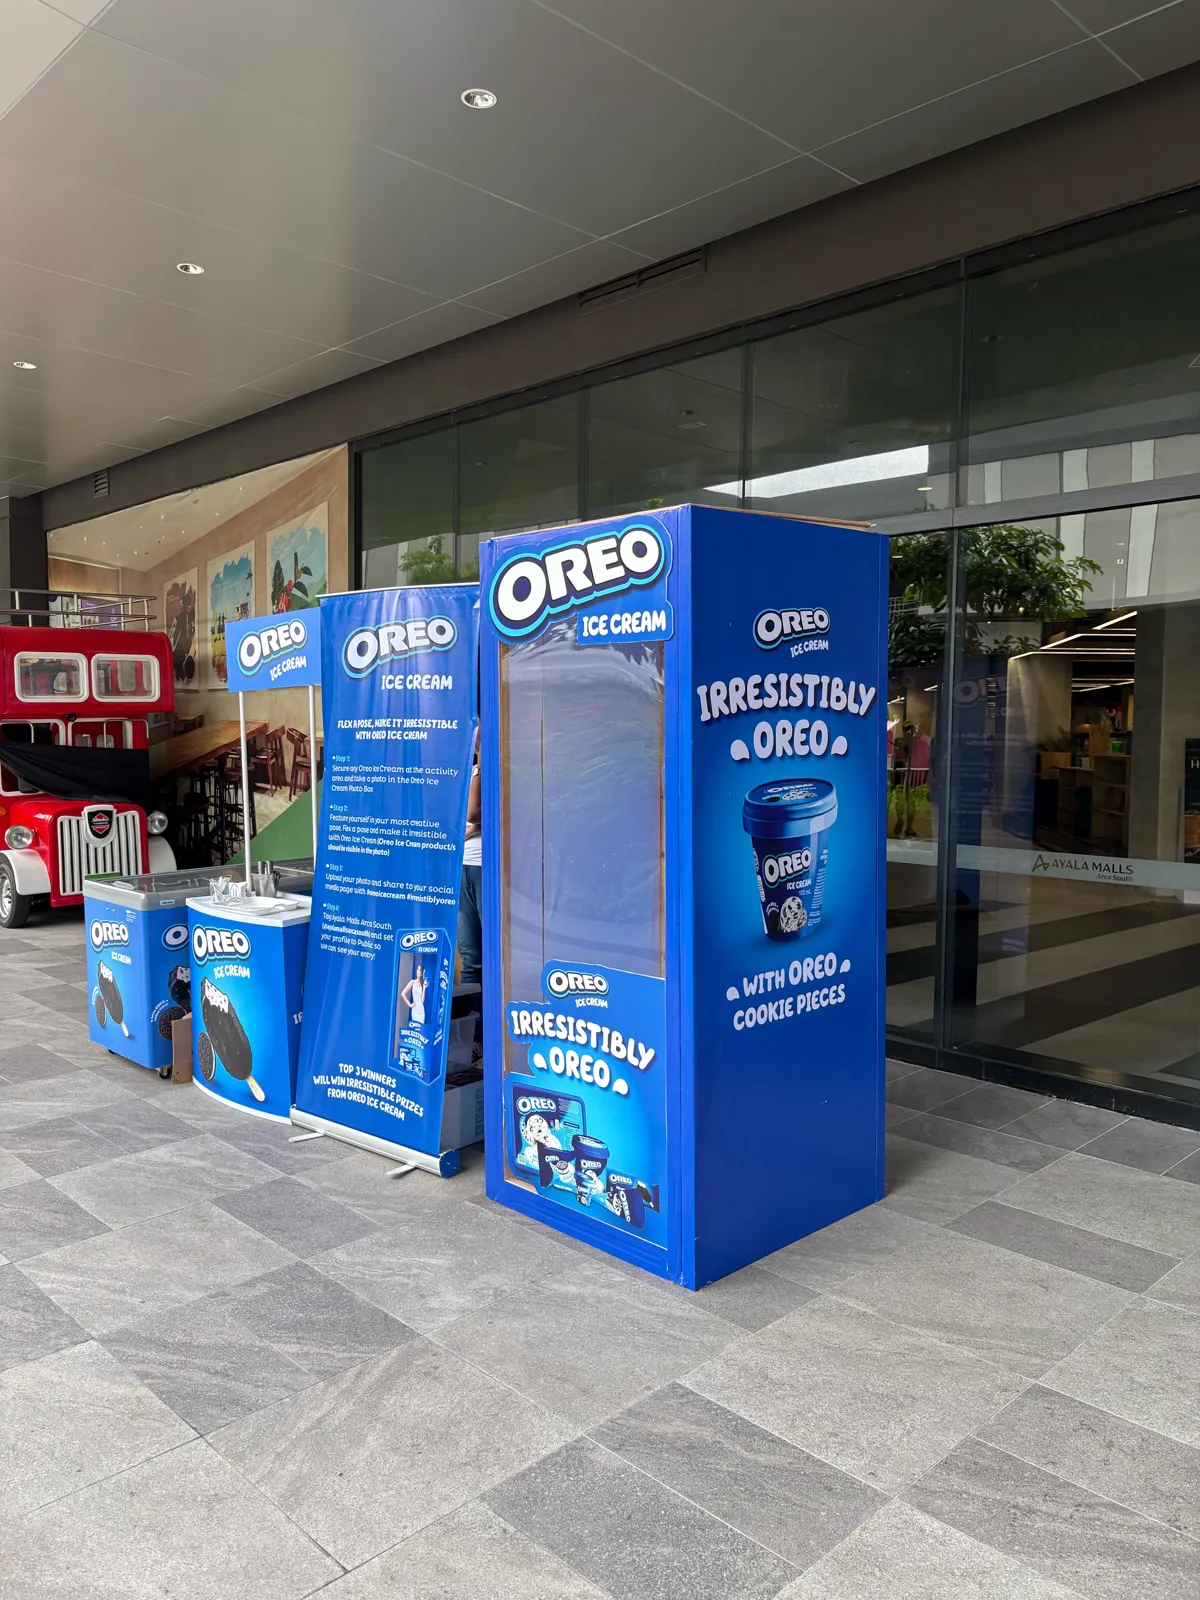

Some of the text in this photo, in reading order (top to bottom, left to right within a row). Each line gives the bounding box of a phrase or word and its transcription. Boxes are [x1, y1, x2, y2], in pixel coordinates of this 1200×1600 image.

[497, 530, 660, 621] OREO
[582, 610, 667, 637] ICE CREAM
[757, 609, 829, 642] OREO
[240, 621, 306, 668] OREO
[346, 618, 454, 669] OREO
[789, 639, 829, 658] ICE CREAM
[269, 655, 307, 682] ICE CREAM
[381, 674, 453, 690] ICE CREAM
[696, 672, 876, 722] IRRESISTIBLY
[337, 720, 352, 729] FLEX
[392, 718, 402, 728] IT
[403, 718, 458, 729] IRRESISTIBLE
[355, 731, 428, 740] WITH OREO ICE CREAM
[753, 719, 829, 759] OREO
[380, 765, 404, 773] Cream
[413, 766, 424, 774] the
[425, 767, 459, 777] activity
[371, 775, 386, 783] photo
[387, 775, 396, 783] in
[397, 776, 410, 784] the
[363, 785, 374, 793] Box
[390, 817, 409, 825] most
[410, 819, 440, 828] creative
[379, 827, 400, 836] make
[402, 827, 408, 836] it
[395, 838, 405, 847] Ice
[421, 841, 456, 851] product/s
[764, 850, 812, 883] OREO
[1051, 859, 1134, 875] AYALA MALLS
[786, 878, 812, 891] ICE CREAM
[1096, 873, 1133, 882] Arca South
[383, 880, 404, 889] share
[405, 882, 413, 890] to
[428, 885, 454, 895] social
[91, 921, 129, 946] OREO
[373, 921, 392, 930] South
[193, 928, 249, 958] OREO
[383, 934, 394, 942] set
[402, 931, 437, 947] OREO
[337, 946, 347, 954] see
[213, 965, 250, 979] ICE CREAM
[742, 952, 837, 997] WITH OREO
[549, 972, 607, 992] OREO
[575, 998, 608, 1009] ICE CREAM
[733, 983, 845, 1031] COOKIE PIECES
[510, 1010, 655, 1070] IRRESISTIBLY
[549, 1046, 611, 1088] OREO
[338, 1063, 397, 1088] TOP 3 WINNERS
[312, 1075, 424, 1118] WILL WIN IRRESISTIBLE PRIZES
[327, 1088, 405, 1121] FROM OREO ICE CREAM
[518, 1097, 556, 1113] OREO
[581, 1160, 602, 1169] OREO
[610, 1174, 633, 1184] OREO
